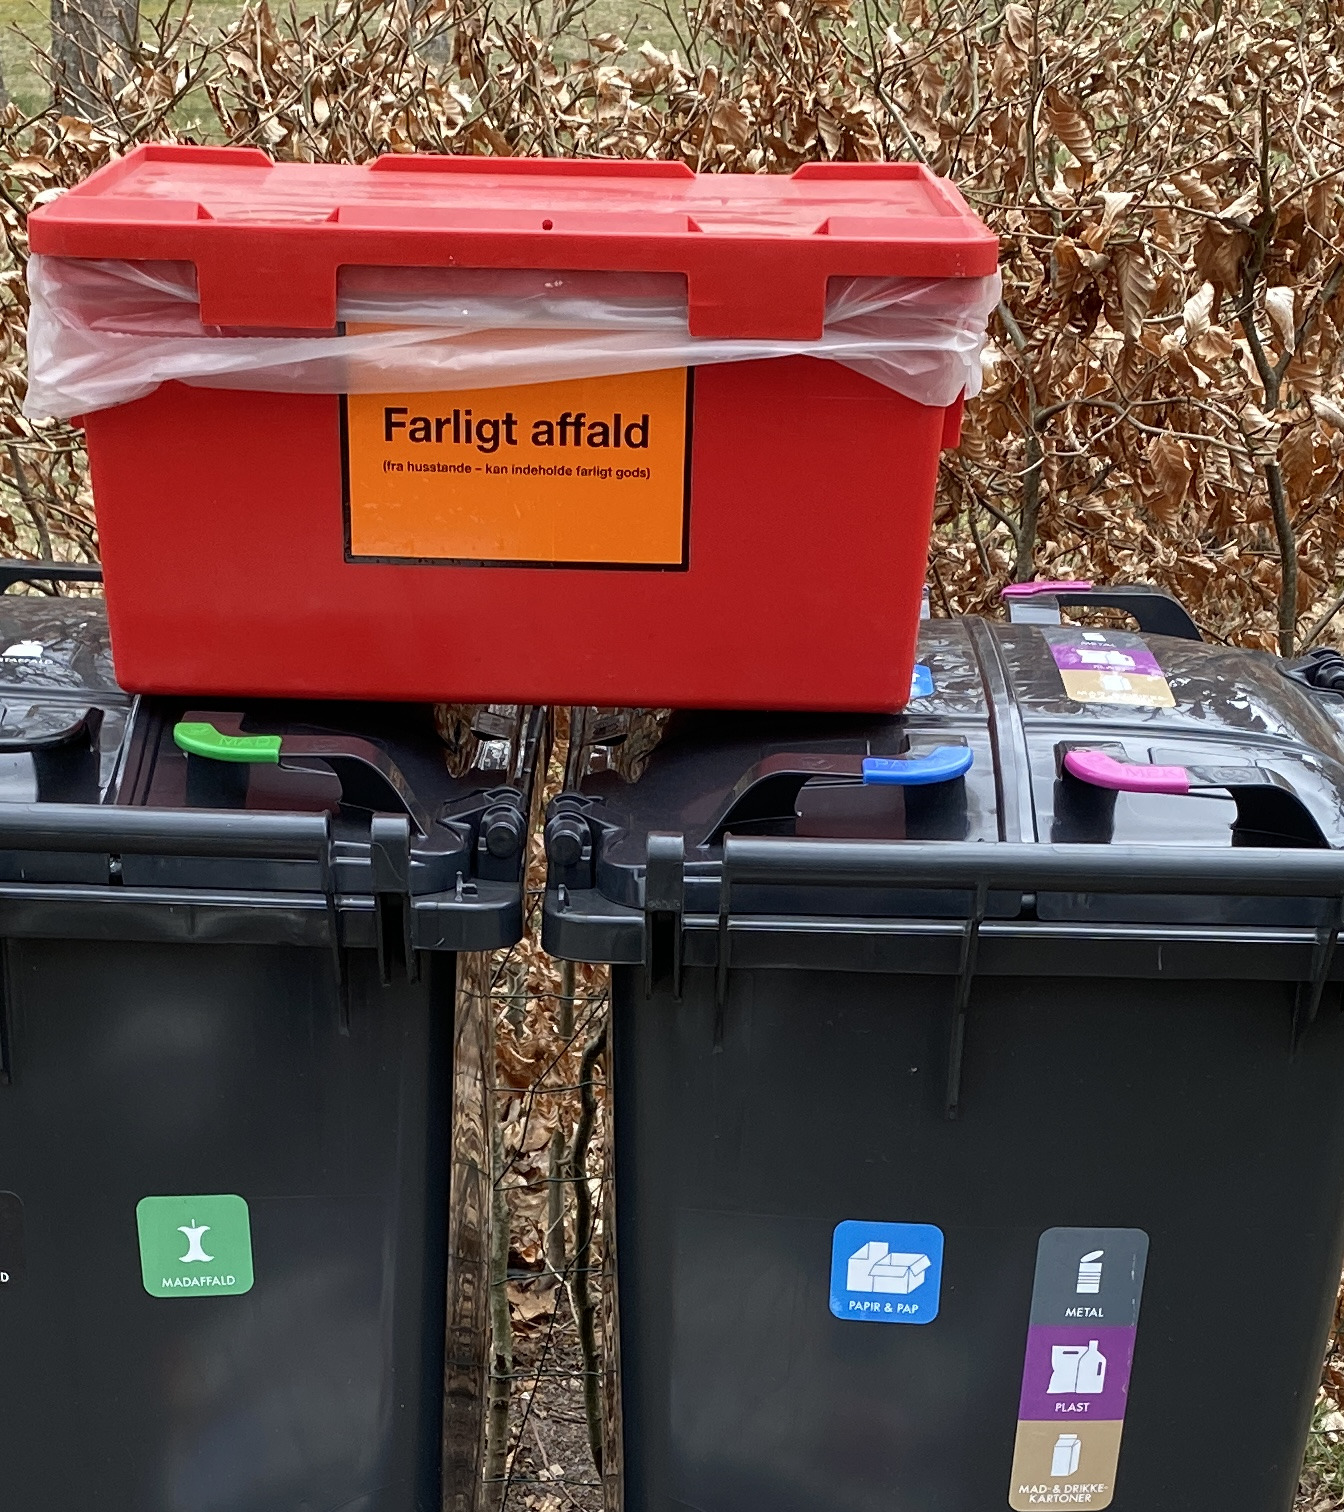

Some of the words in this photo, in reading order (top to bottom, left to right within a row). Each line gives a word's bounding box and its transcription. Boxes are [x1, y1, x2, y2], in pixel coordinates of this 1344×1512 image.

[383, 406, 518, 453] Farligt
[530, 411, 650, 449] affald
[382, 460, 404, 474] (fra
[406, 461, 472, 474] husstande
[485, 463, 508, 475] kan
[511, 464, 572, 477] indeholde
[575, 465, 613, 480] farligt
[615, 467, 651, 480] gods)
[161, 1275, 236, 1288] MADAFFALD
[848, 1300, 881, 1313] PAPIR
[884, 1303, 893, 1313] &
[896, 1303, 919, 1315] PAP
[1065, 1307, 1104, 1318] METAL
[1055, 1402, 1090, 1413] PLAST
[1029, 1493, 1092, 1503] KARTONER
